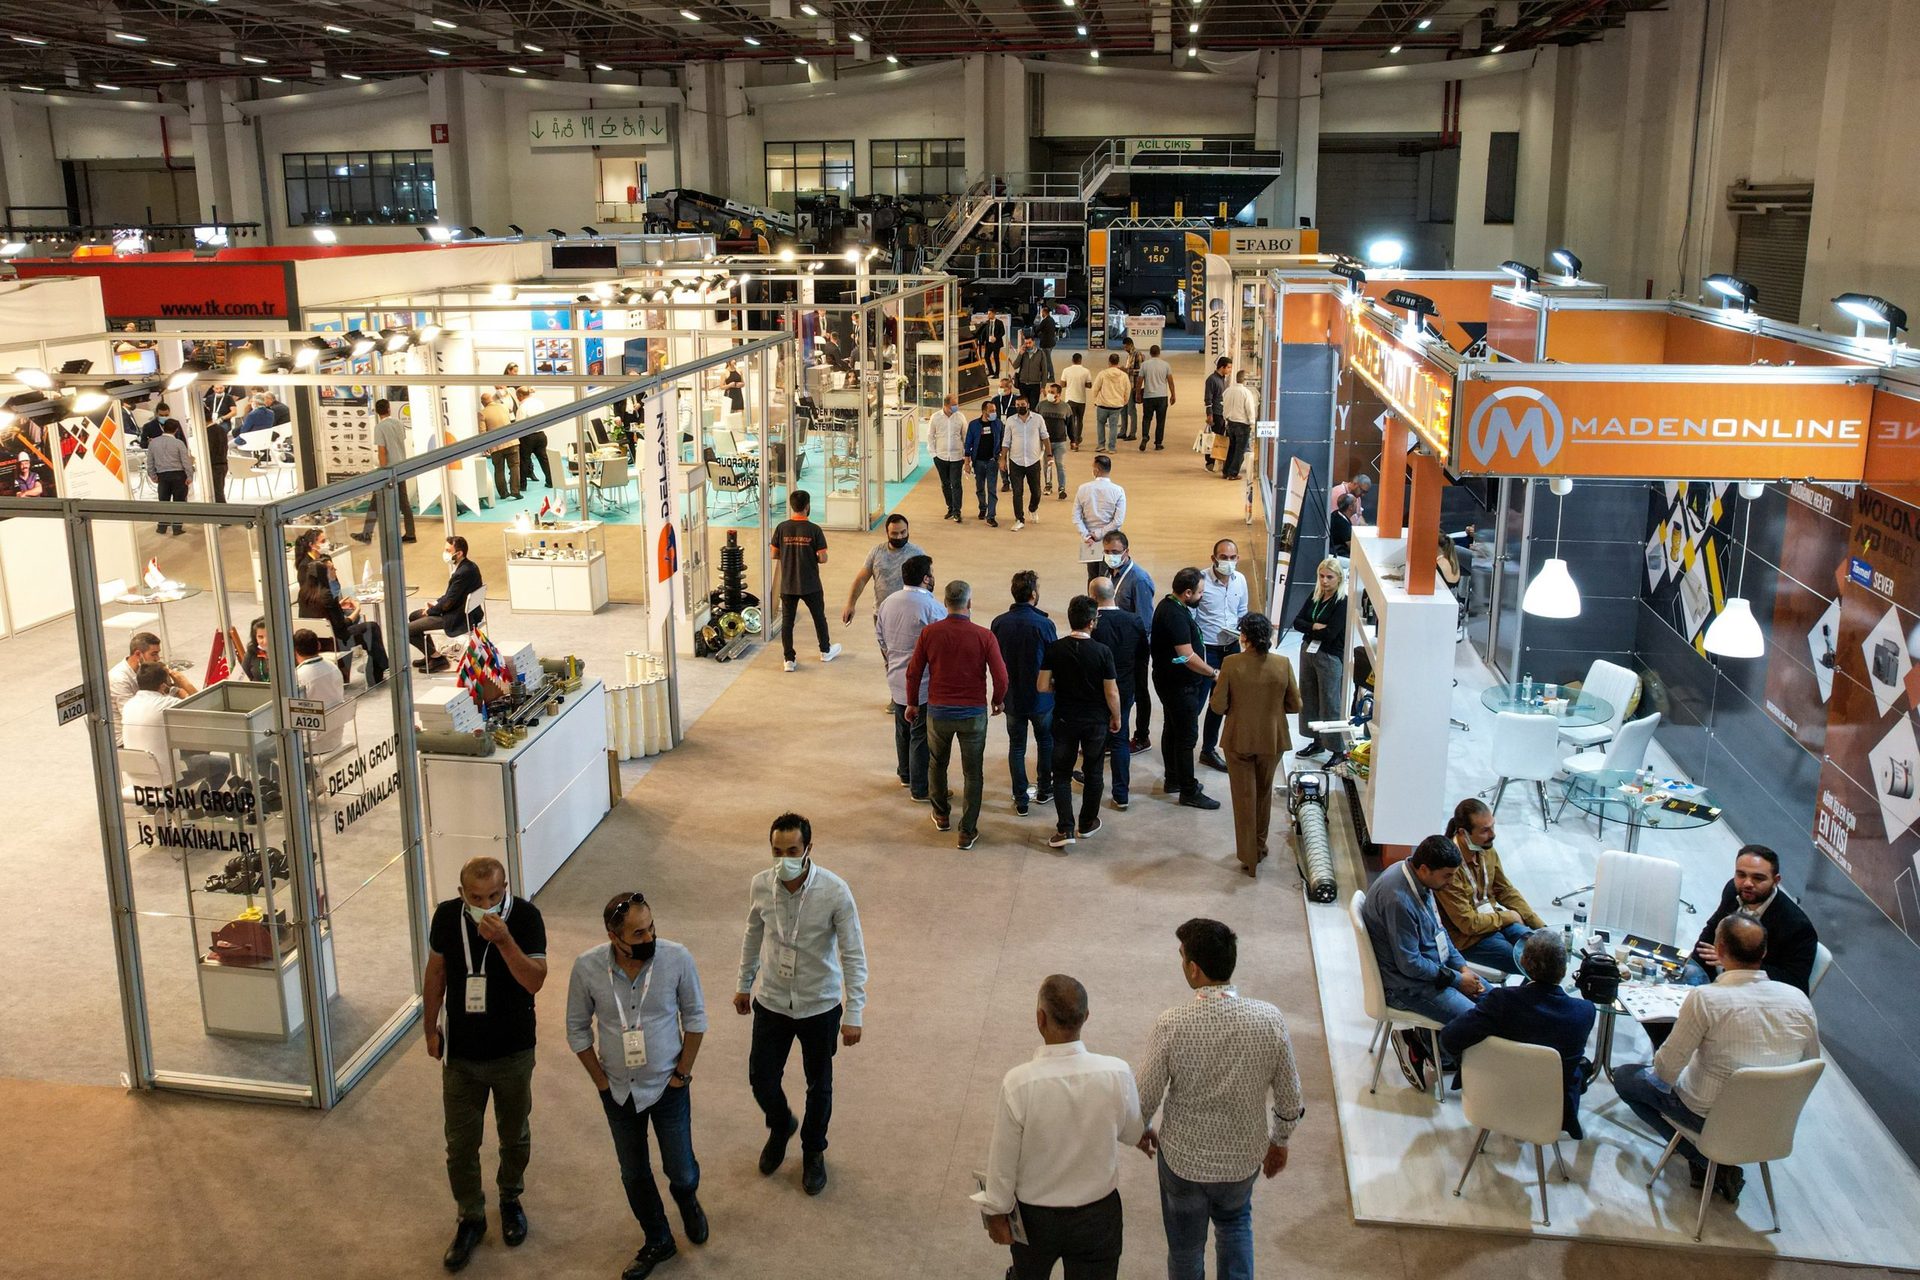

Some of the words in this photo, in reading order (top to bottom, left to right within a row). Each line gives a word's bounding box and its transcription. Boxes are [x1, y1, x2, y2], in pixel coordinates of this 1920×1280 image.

[1246, 238, 1292, 251] FABO
[1148, 255, 1165, 263] 150
[161, 299, 275, 316] www.tk.com.tr
[1571, 416, 1863, 440] MADENONLINE
[656, 412, 669, 519] DELSAN
[1873, 571, 1895, 597] SEVER
[62, 702, 83, 722] A120
[295, 715, 321, 729] A120
[328, 758, 368, 798] DELSAN
[368, 733, 400, 770] GROUP
[133, 785, 196, 811] DELSAN
[200, 788, 256, 815] GROUP
[334, 810, 345, 835] İŞ
[1818, 808, 1831, 839] EN
[138, 820, 154, 850] İŞ
[157, 823, 256, 852] MAKİNALARI
